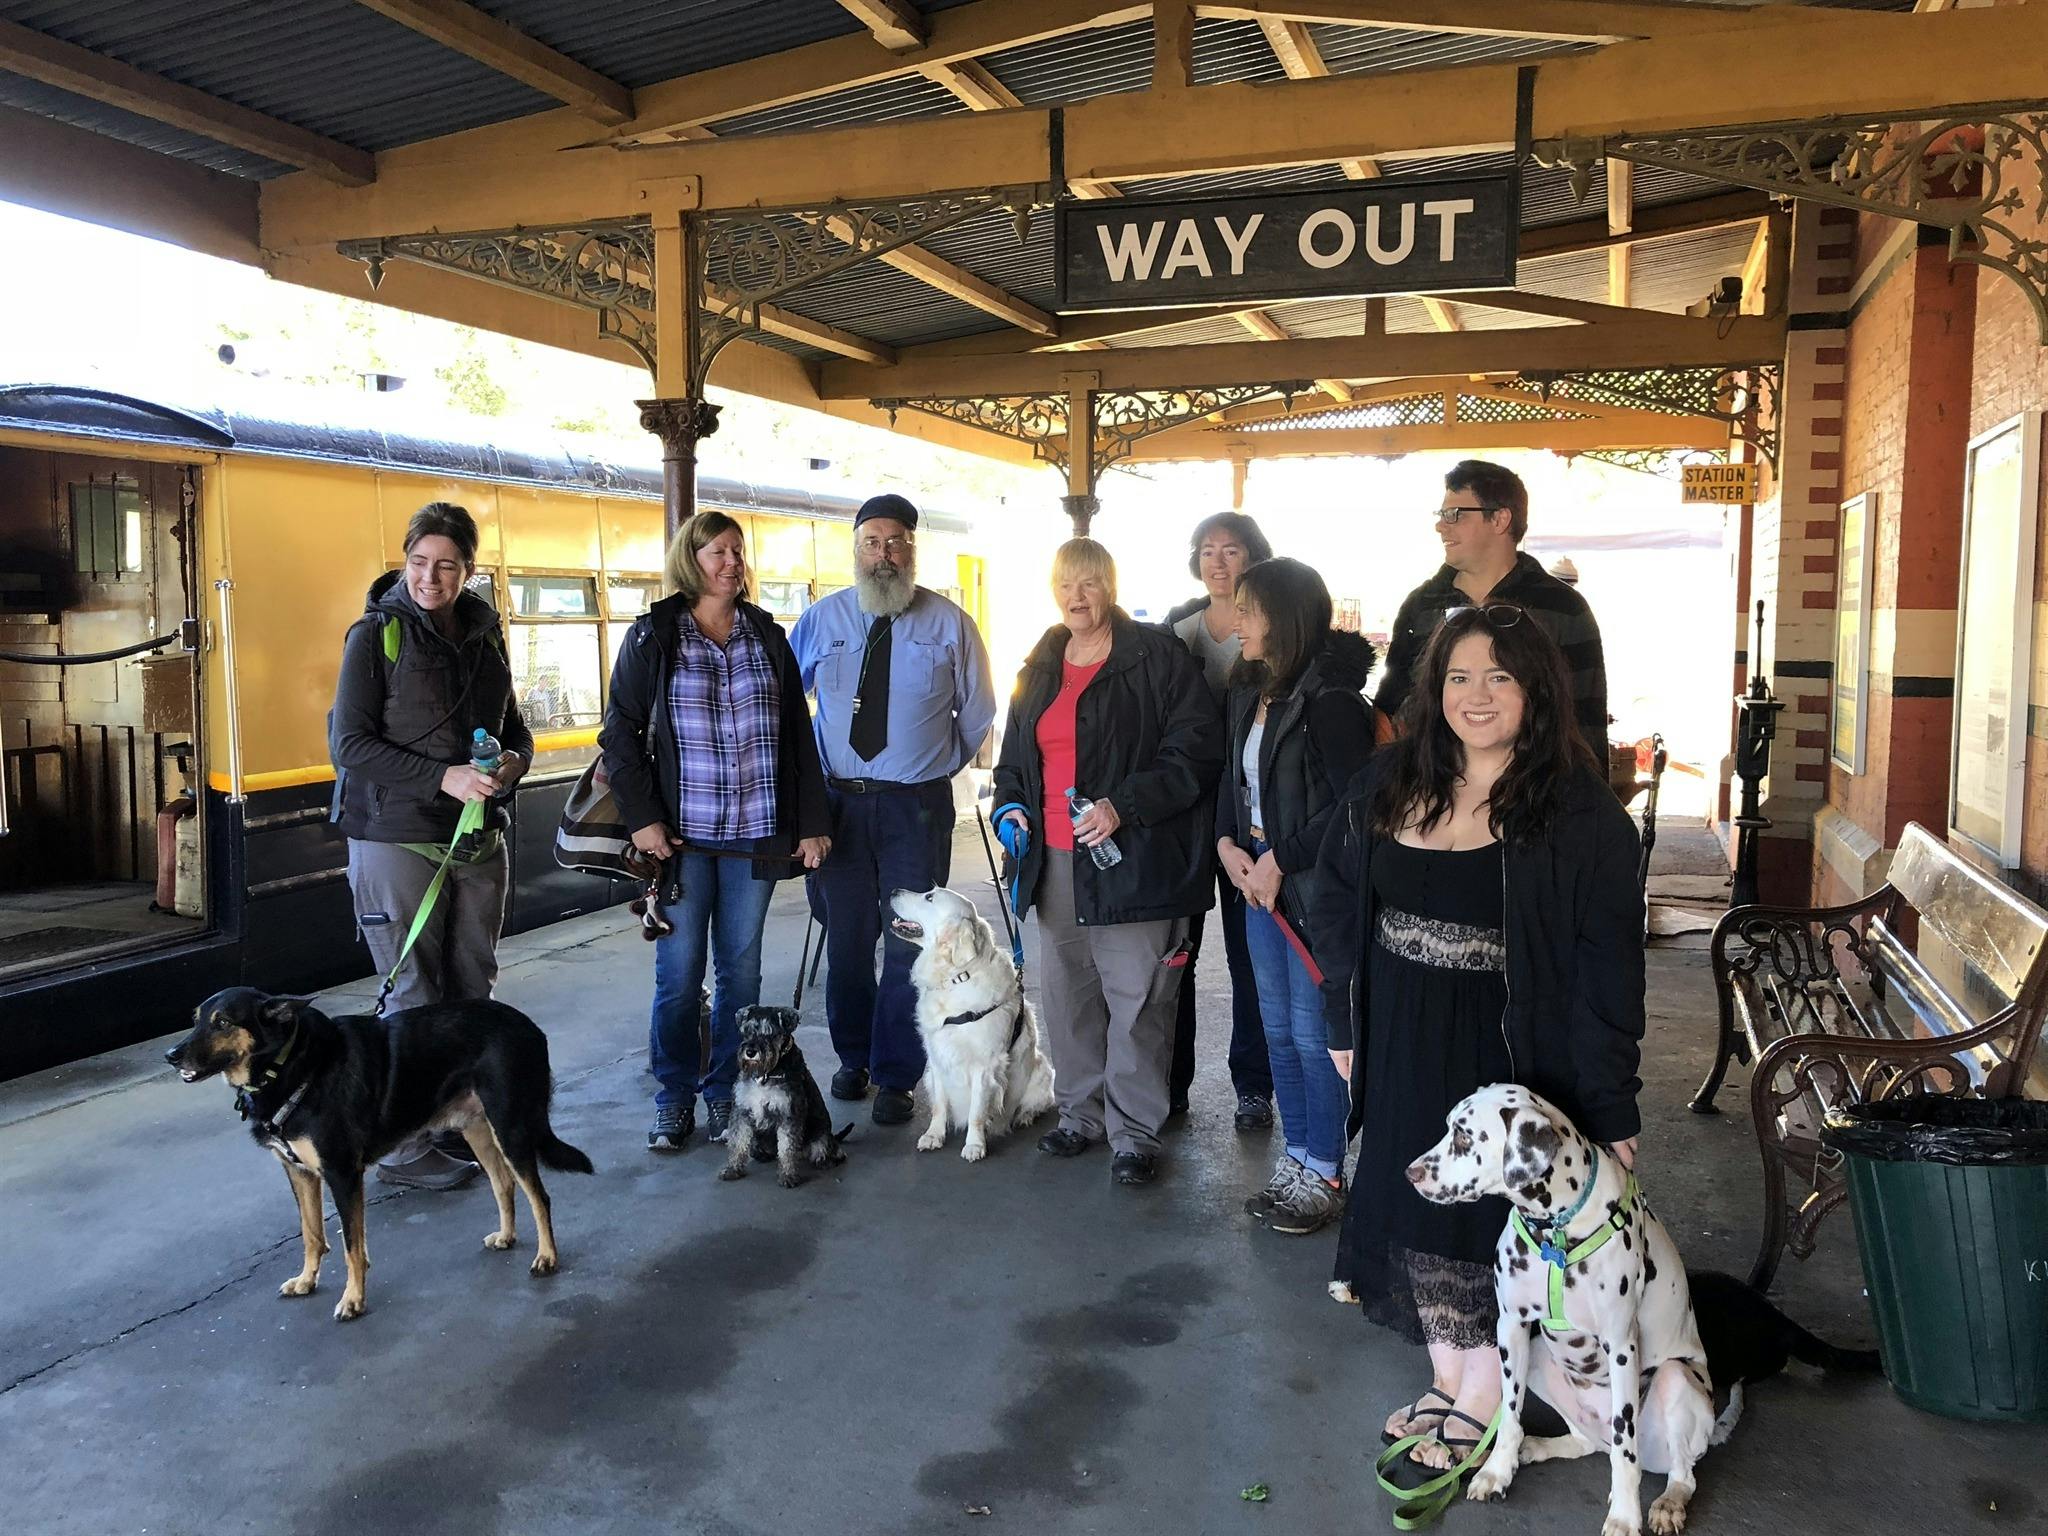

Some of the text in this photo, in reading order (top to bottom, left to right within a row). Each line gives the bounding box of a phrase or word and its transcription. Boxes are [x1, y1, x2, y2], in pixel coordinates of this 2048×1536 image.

[1096, 198, 1474, 282] WAY OUT
[1685, 467, 1746, 482] STATION
[1685, 485, 1744, 500] MASTER
